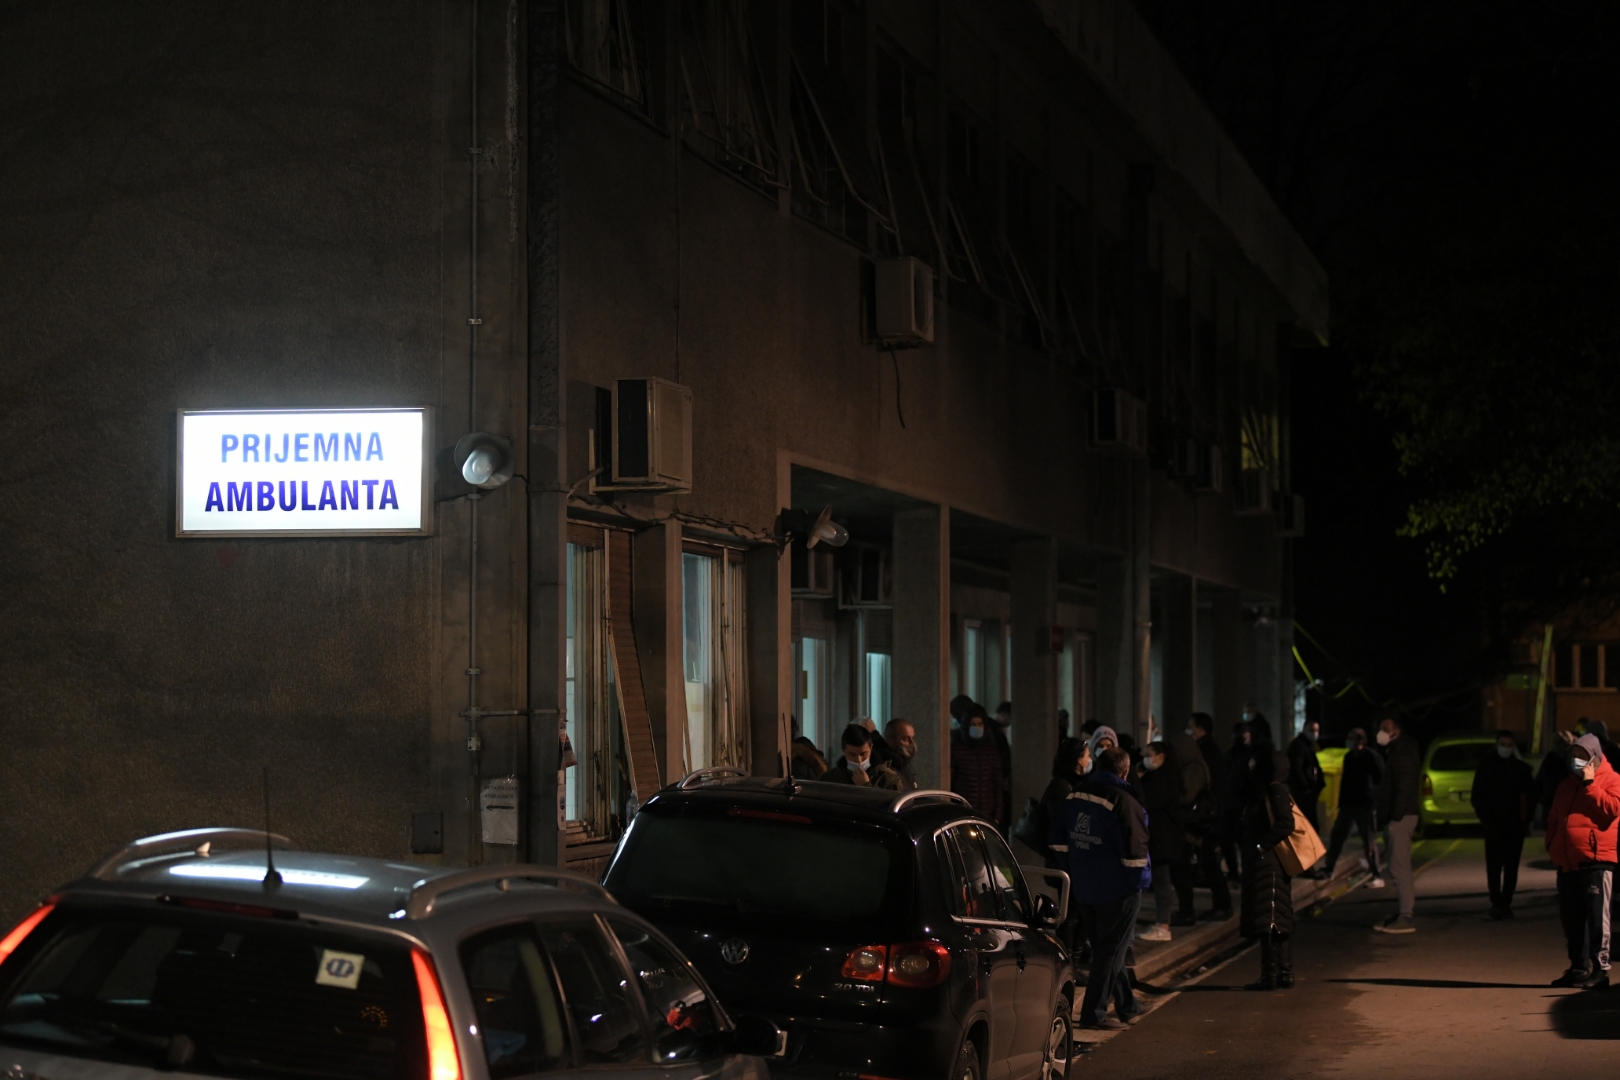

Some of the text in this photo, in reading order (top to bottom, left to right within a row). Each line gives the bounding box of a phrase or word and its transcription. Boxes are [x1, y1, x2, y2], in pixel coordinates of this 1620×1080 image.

[221, 432, 384, 463] PRIJEMNA
[205, 479, 399, 512] AMBULANTA
[854, 984, 875, 992] TDI
